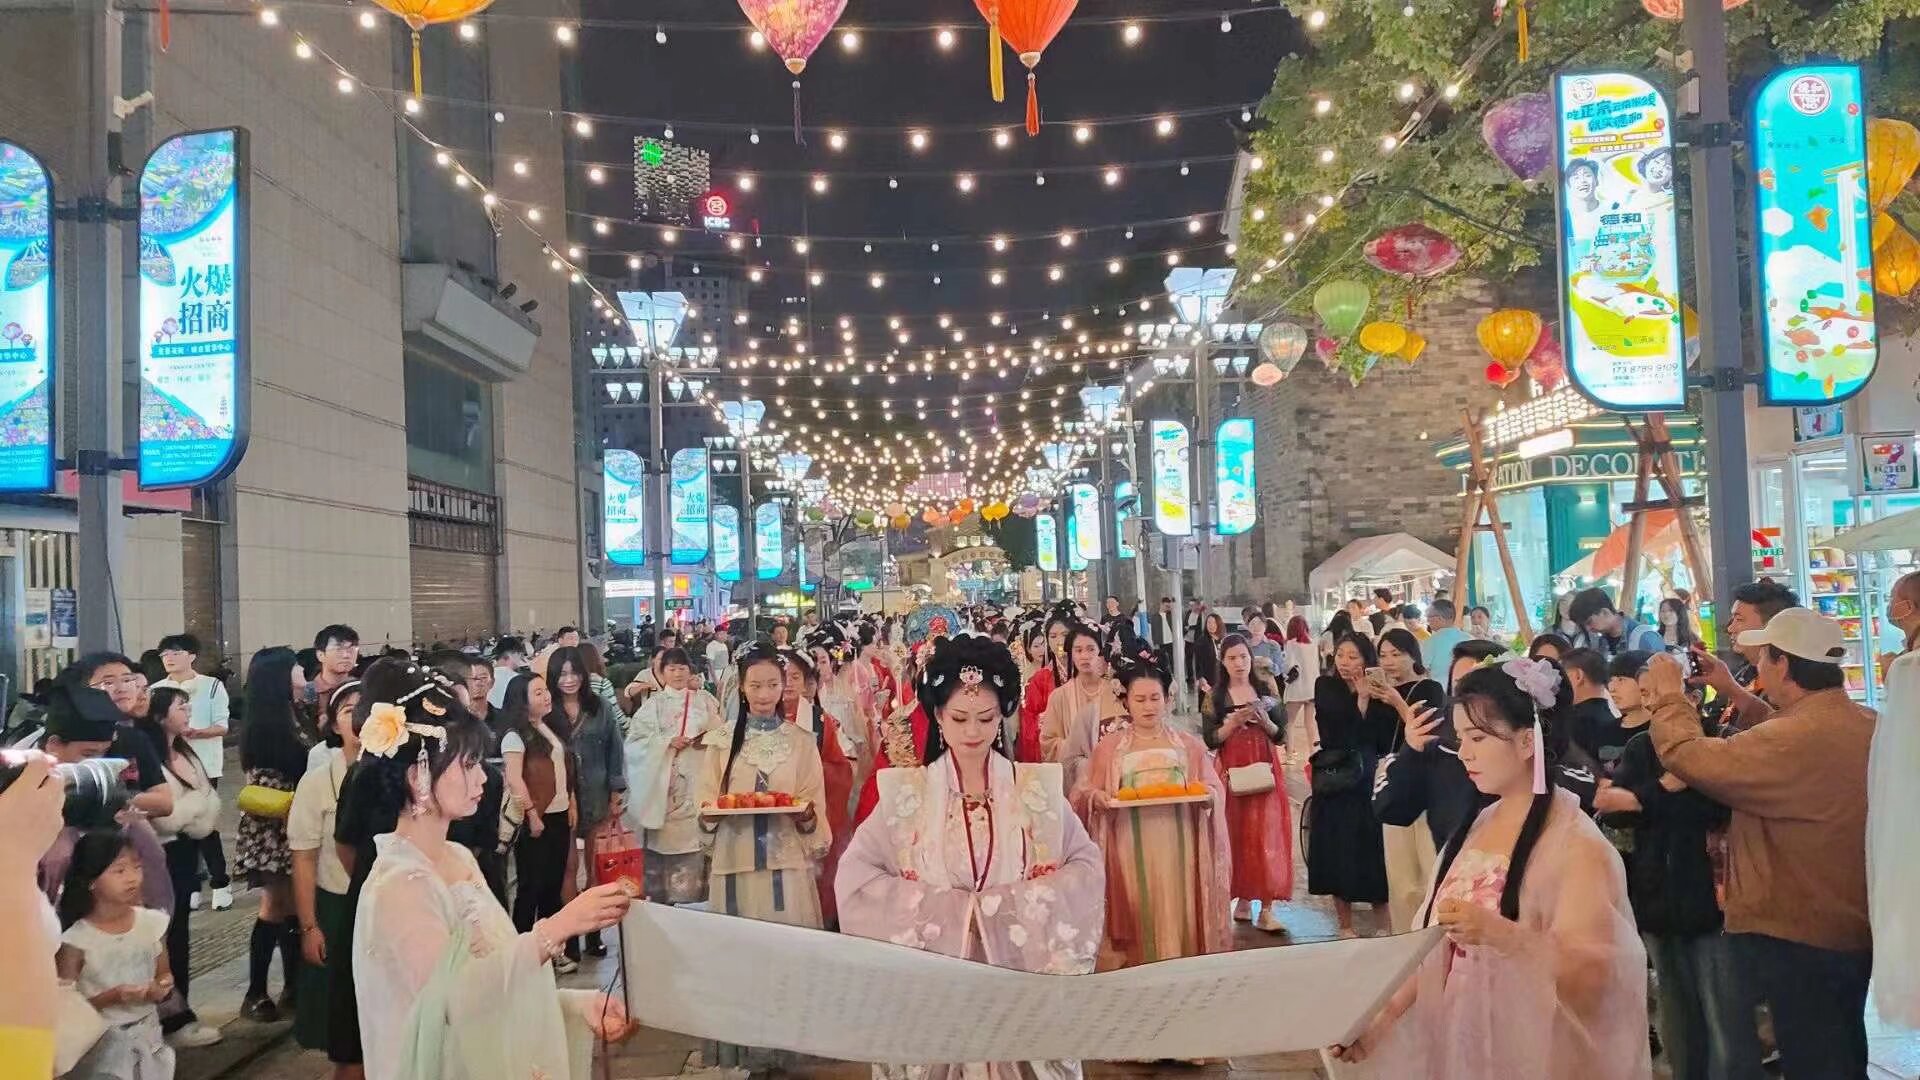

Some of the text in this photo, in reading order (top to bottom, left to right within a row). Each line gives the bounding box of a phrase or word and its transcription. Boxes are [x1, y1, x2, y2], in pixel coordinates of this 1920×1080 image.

[704, 216, 730, 228] ICBC
[179, 263, 231, 299] 火爆
[178, 300, 229, 335] 招商
